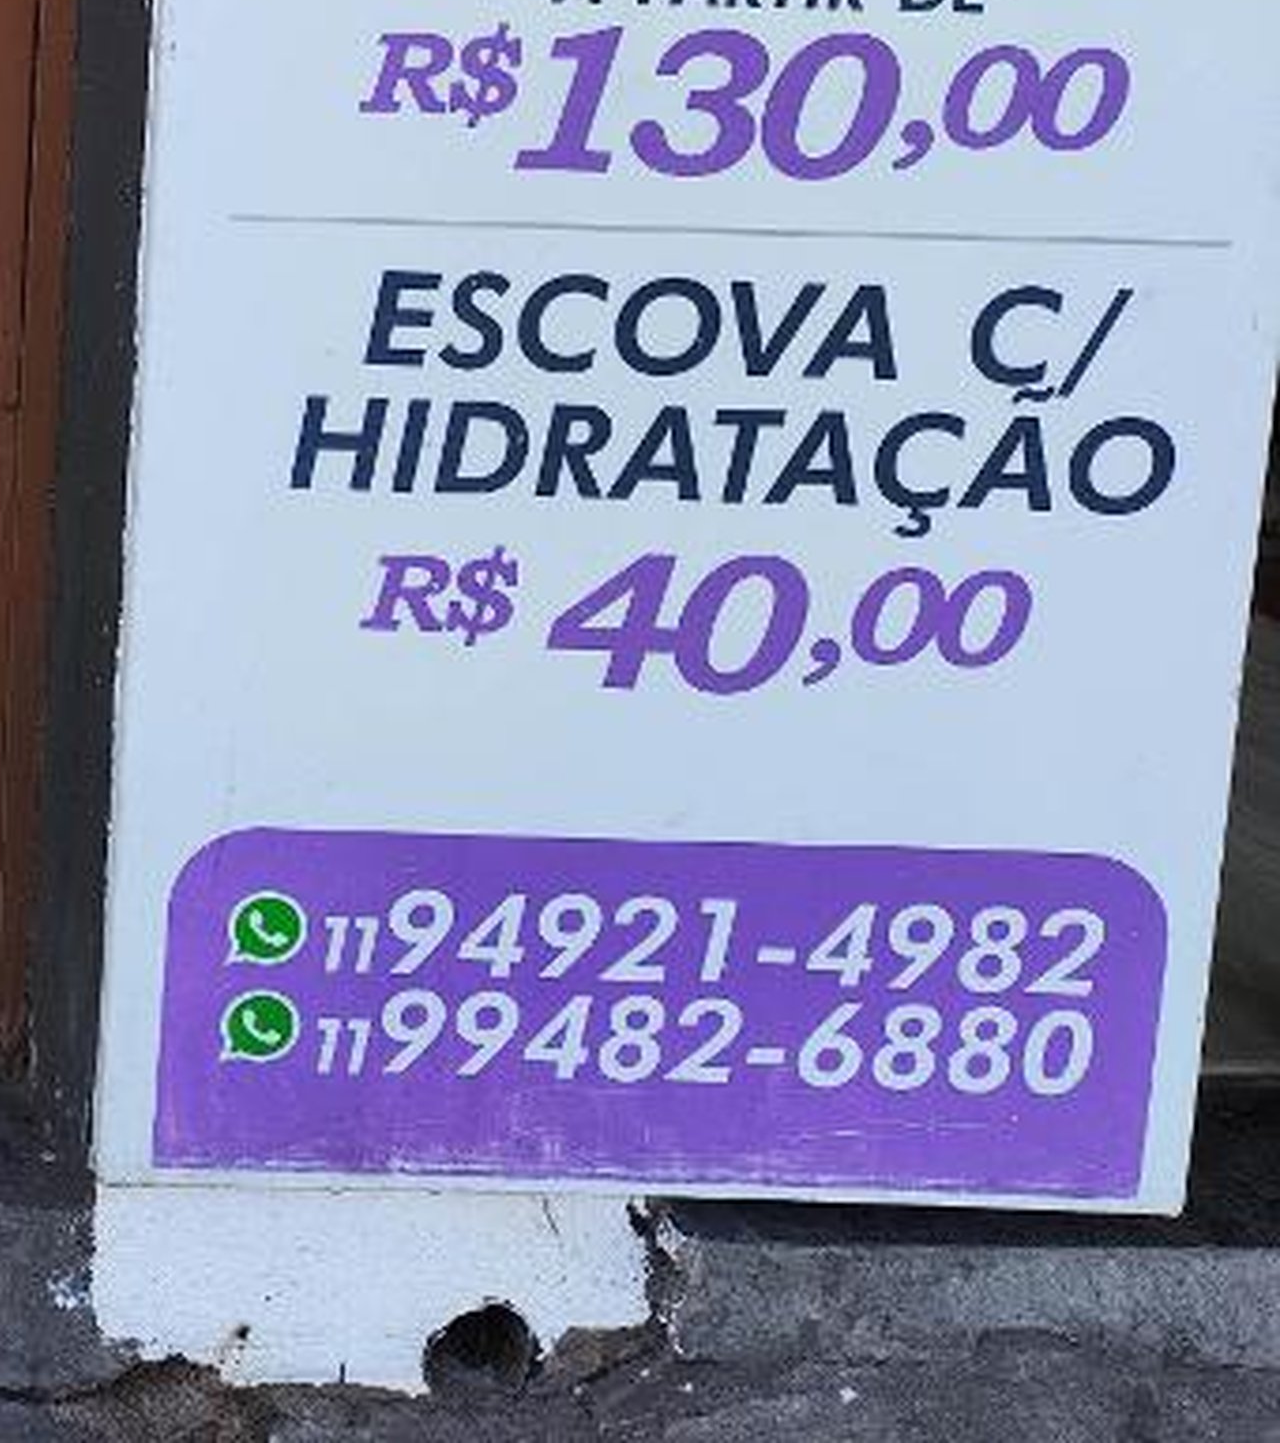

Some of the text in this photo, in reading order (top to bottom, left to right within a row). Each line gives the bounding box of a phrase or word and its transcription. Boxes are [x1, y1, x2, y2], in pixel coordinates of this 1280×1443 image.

[363, 269, 1136, 399] ESCOVA C/
[288, 386, 1177, 538] HIDRATAÇÃO
